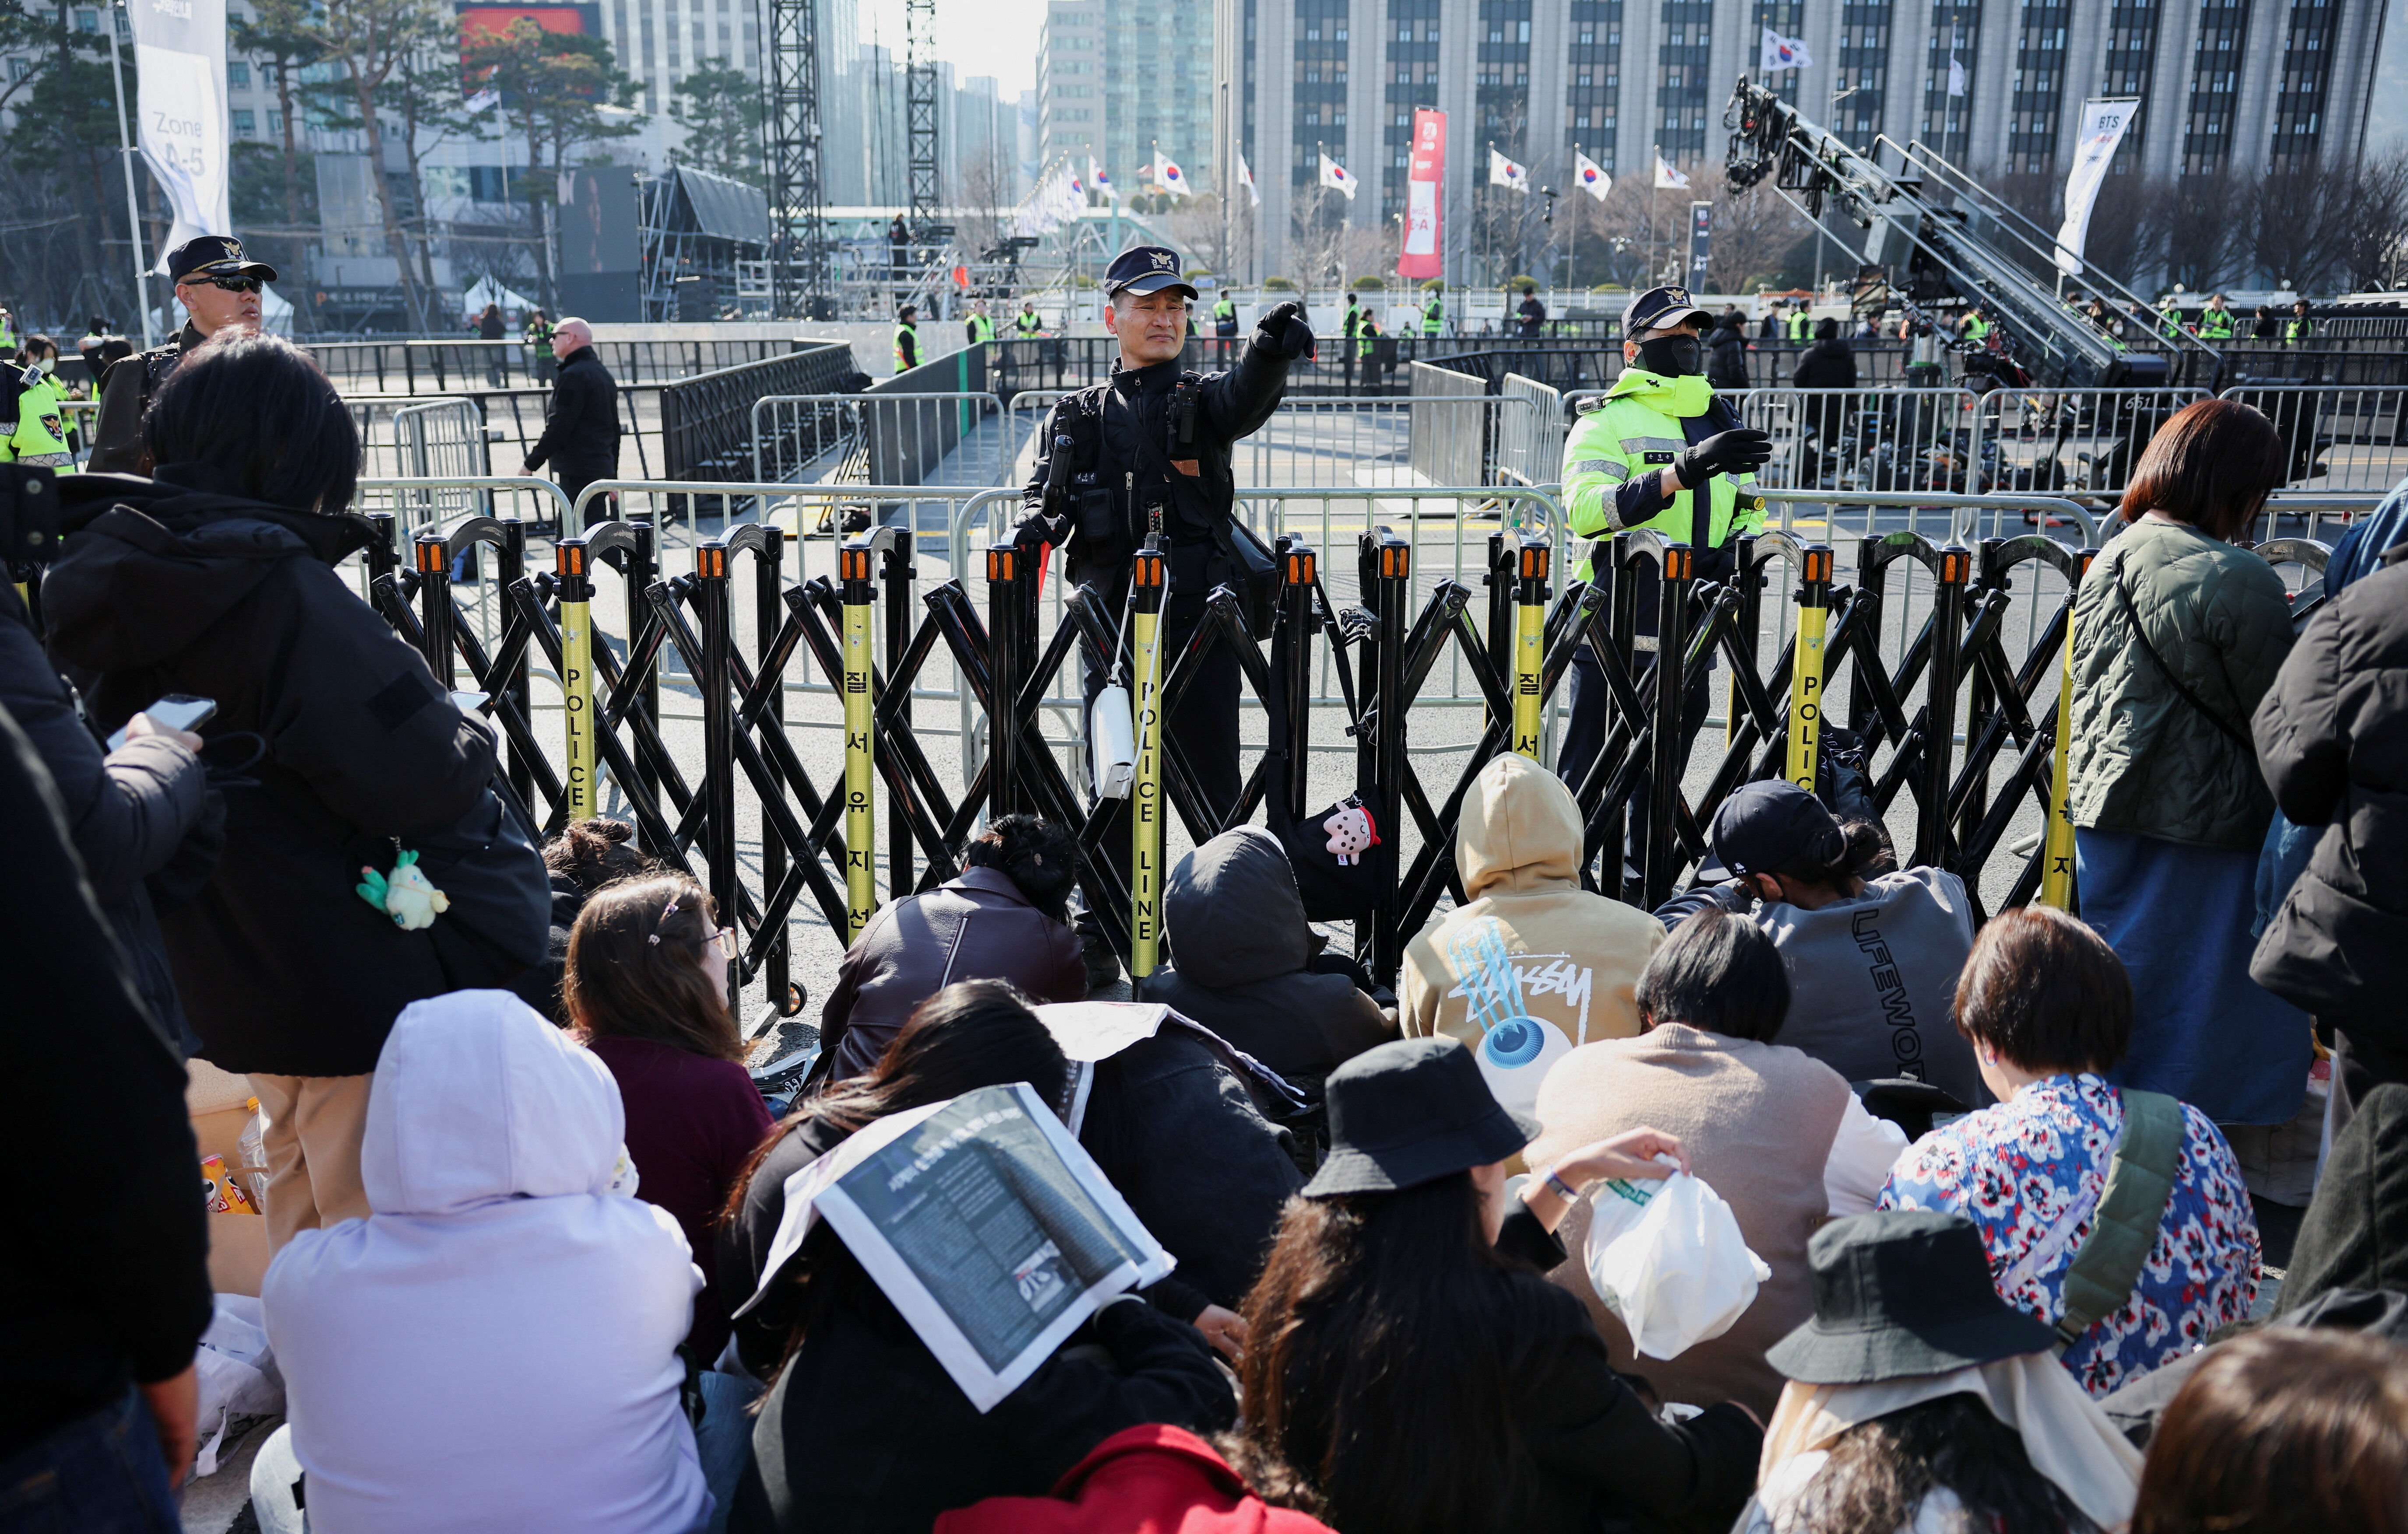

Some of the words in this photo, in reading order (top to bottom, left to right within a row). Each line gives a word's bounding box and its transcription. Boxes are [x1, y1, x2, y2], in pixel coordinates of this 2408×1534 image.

[153, 111, 201, 137] Zone
[165, 143, 205, 176] A-5
[2099, 116, 2119, 129] BTS
[1707, 462, 1719, 471] POLIC
[567, 668, 585, 806] POLICE
[1138, 682, 1155, 822] POLICE
[1517, 673, 1540, 756] 질서
[846, 672, 869, 929] 질서유지선
[1138, 851, 1152, 940] LINE
